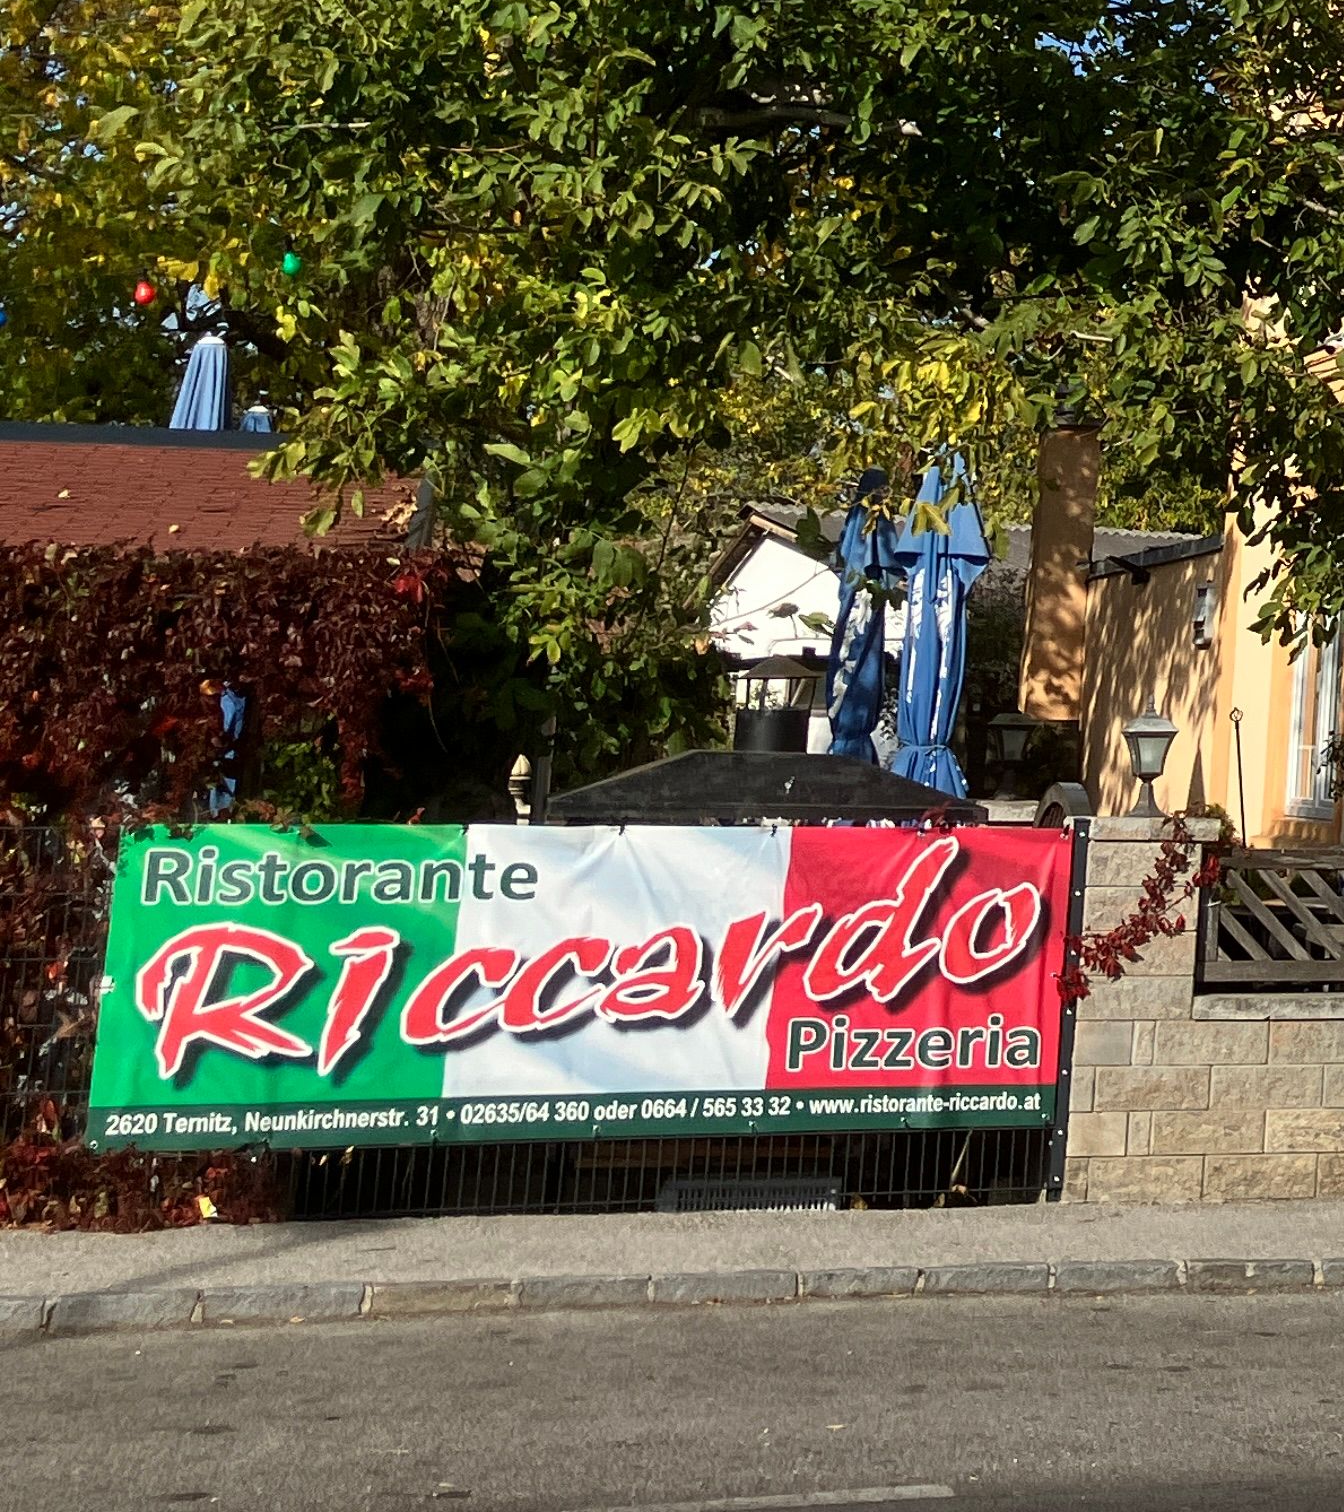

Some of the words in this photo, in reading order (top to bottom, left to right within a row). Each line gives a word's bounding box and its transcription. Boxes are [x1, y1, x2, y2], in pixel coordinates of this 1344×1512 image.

[141, 845, 540, 906] Ristorante
[135, 836, 1042, 1080] Riccardo
[785, 1014, 1042, 1072] Pizzeria
[105, 1113, 158, 1136] 2620
[163, 1111, 238, 1135] Ternitz,
[245, 1106, 410, 1133] Neunkirchnerstr.
[416, 1105, 440, 1127] 31
[460, 1102, 551, 1124] 02635/64
[554, 1101, 590, 1122] 360
[593, 1100, 638, 1121] oder
[641, 1098, 687, 1120] 0664
[690, 1098, 700, 1118] /
[702, 1097, 738, 1118] 565
[740, 1096, 765, 1117] 33
[768, 1095, 792, 1116] 32
[808, 1092, 1042, 1114] www.ristorante-riccardo.at
